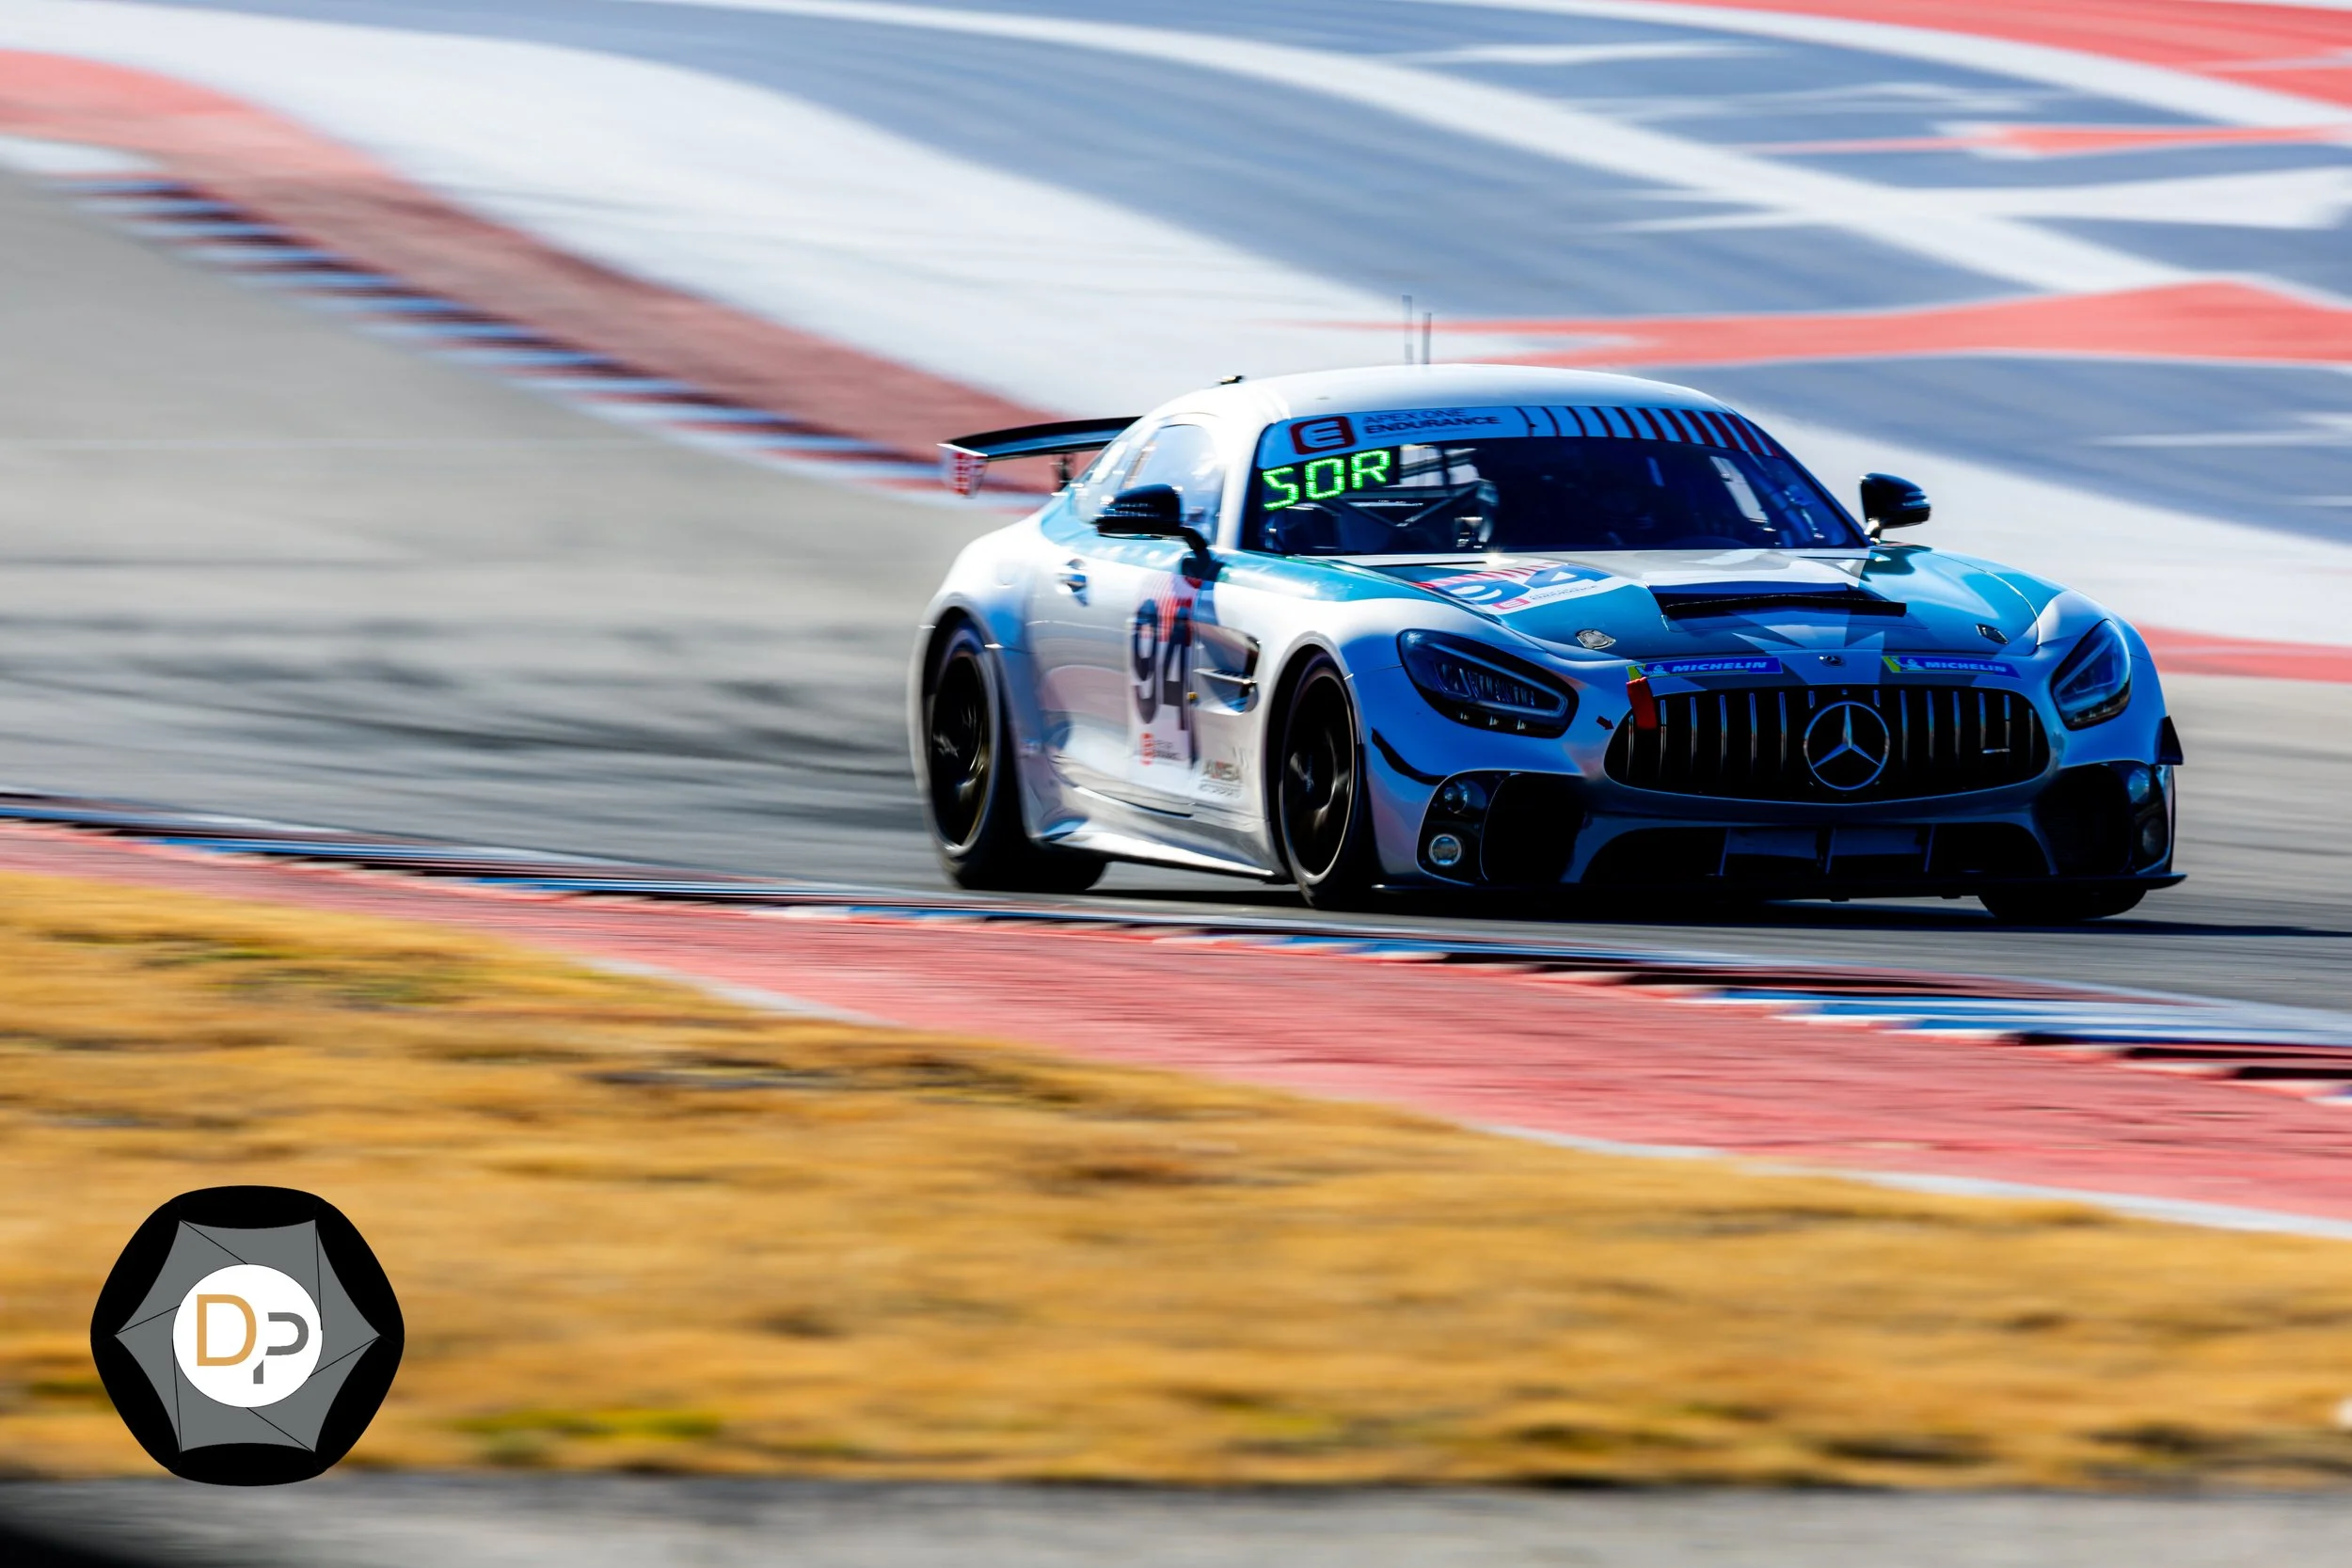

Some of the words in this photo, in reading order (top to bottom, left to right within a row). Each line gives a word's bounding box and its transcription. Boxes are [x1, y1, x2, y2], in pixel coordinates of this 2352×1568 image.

[1365, 416, 1501, 434] ENDURANCE
[1132, 598, 1189, 731] 94
[1671, 661, 1767, 673] MICHELIN
[1925, 661, 2007, 673] MICHELIN
